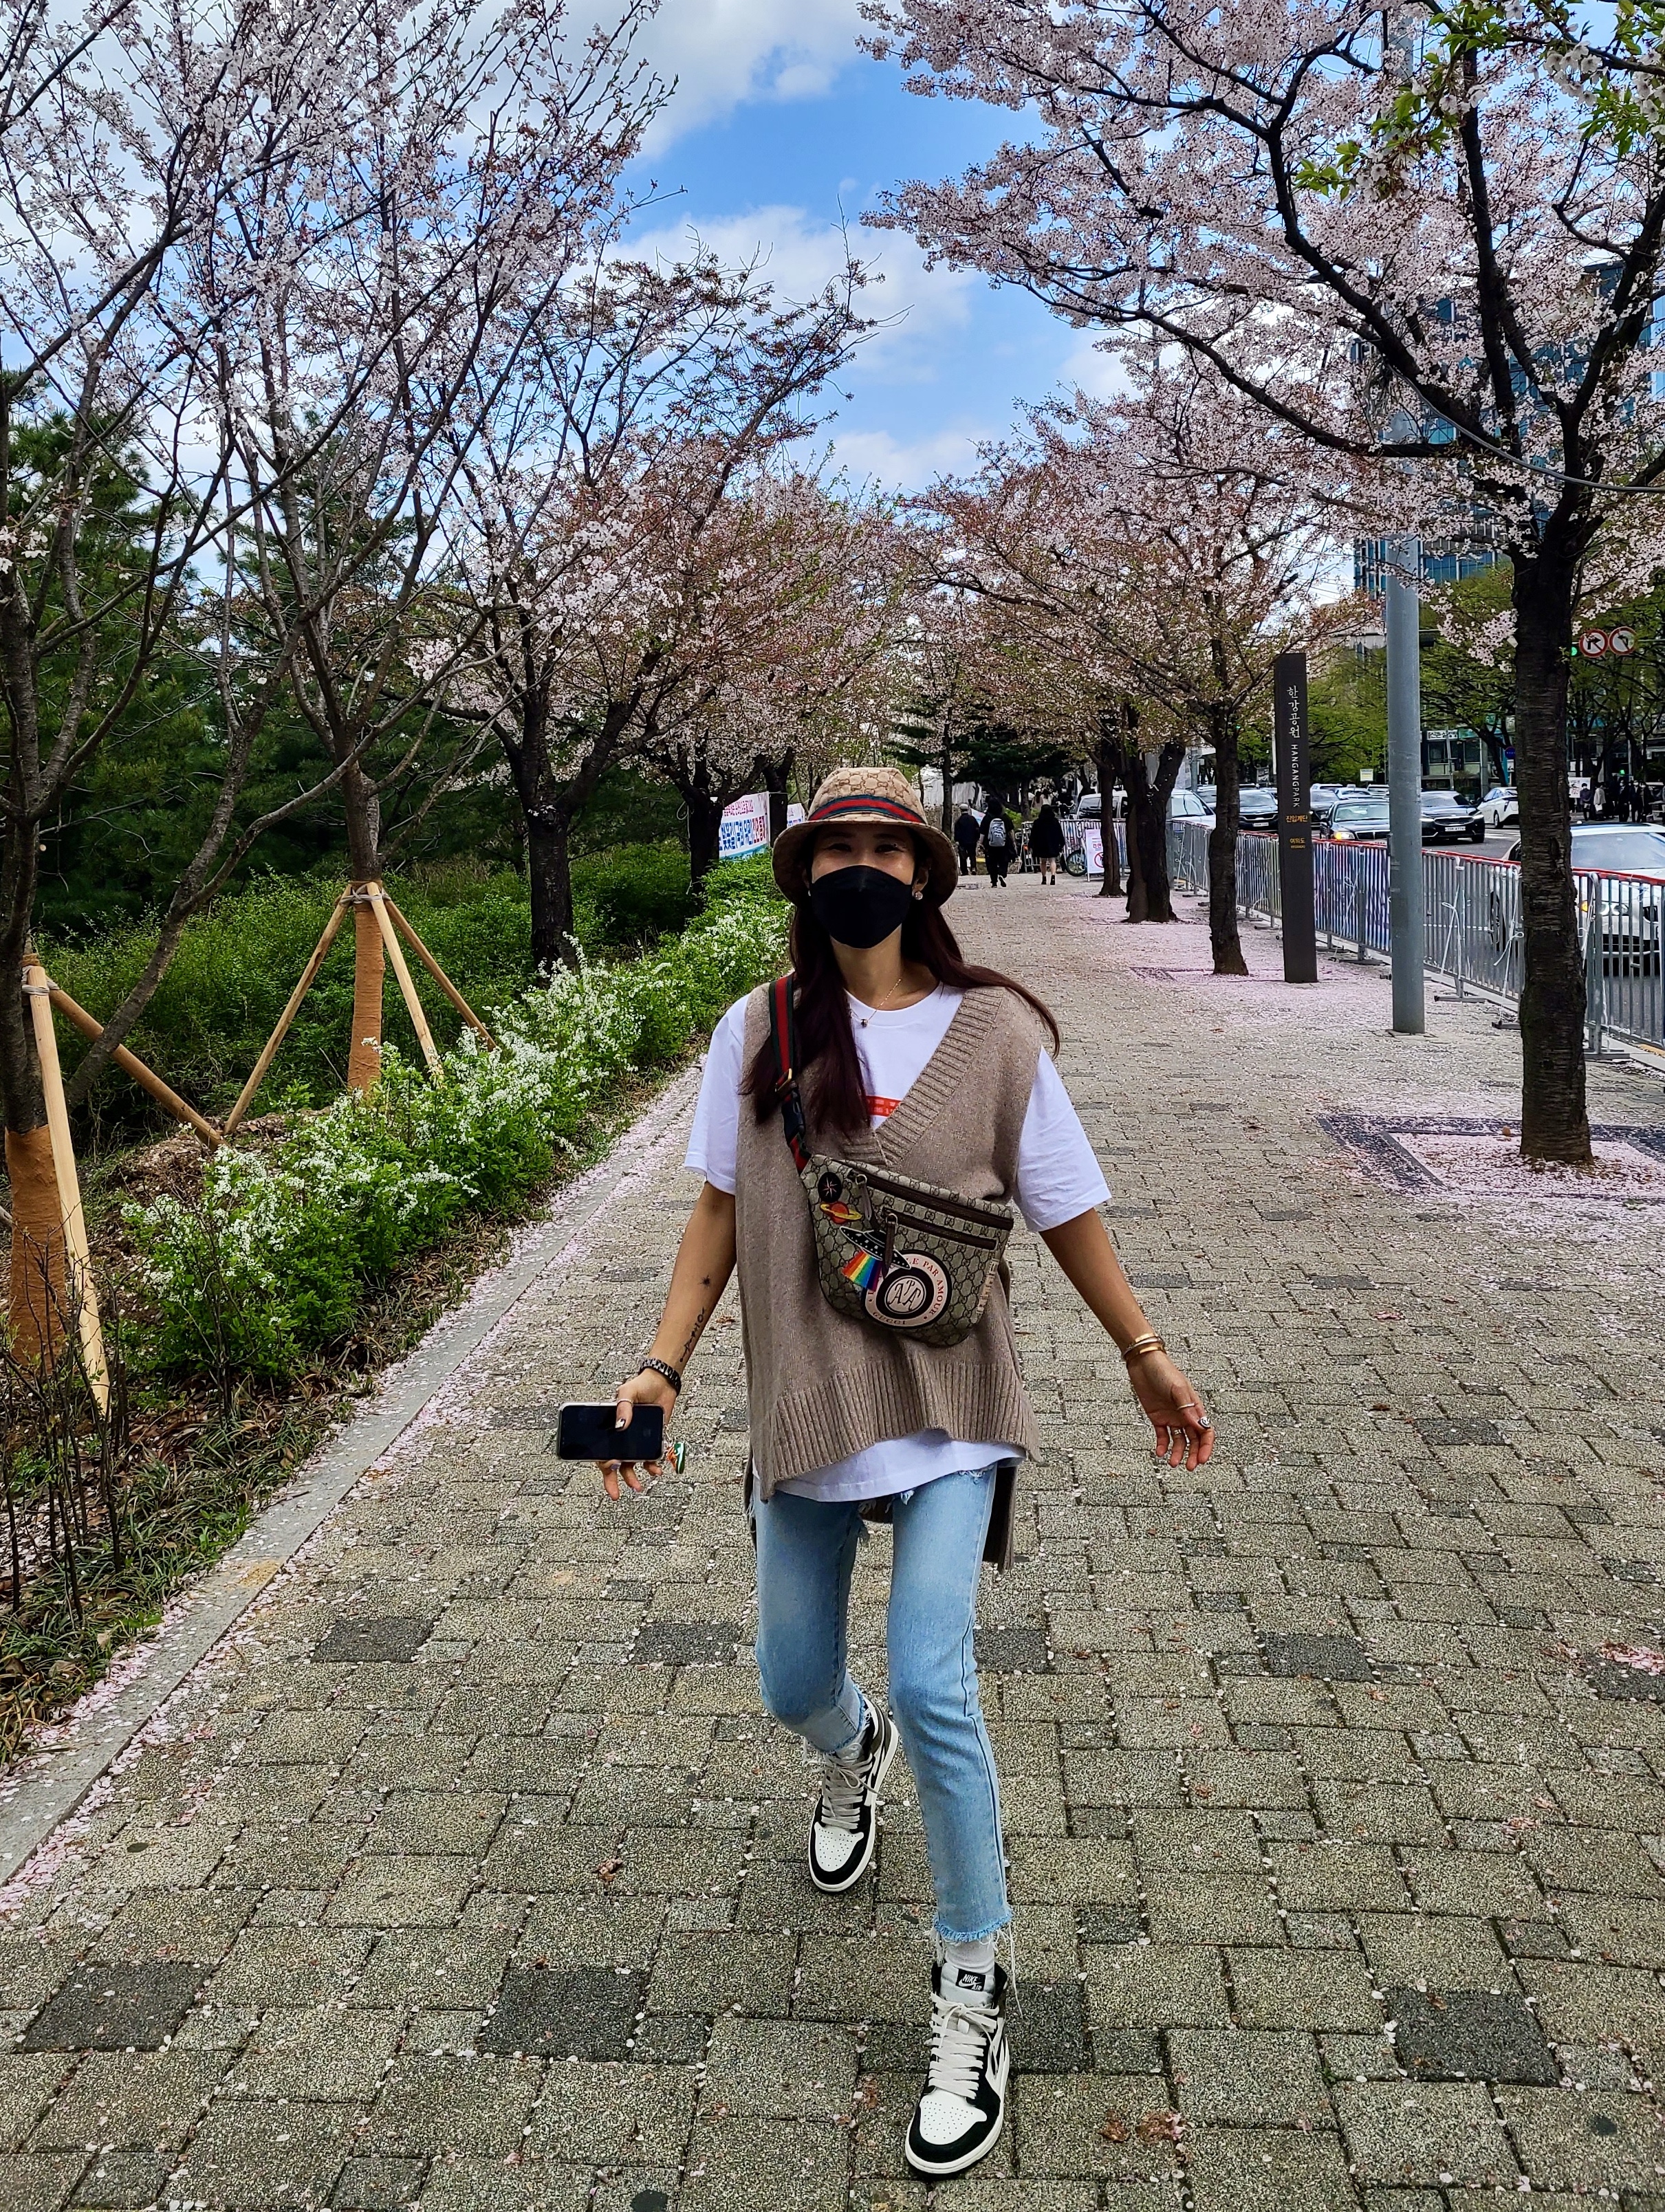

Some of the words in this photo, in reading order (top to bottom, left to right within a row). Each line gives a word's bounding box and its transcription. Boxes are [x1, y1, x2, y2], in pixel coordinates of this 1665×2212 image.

[1286, 685, 1301, 738] 한강공원
[1291, 744, 1301, 807] HANGANGPARK
[922, 1260, 939, 1276] PAR
[929, 1279, 944, 1315] AMOUR
[872, 1312, 906, 1325] GUCCI
[962, 1974, 978, 1984] NIKE
